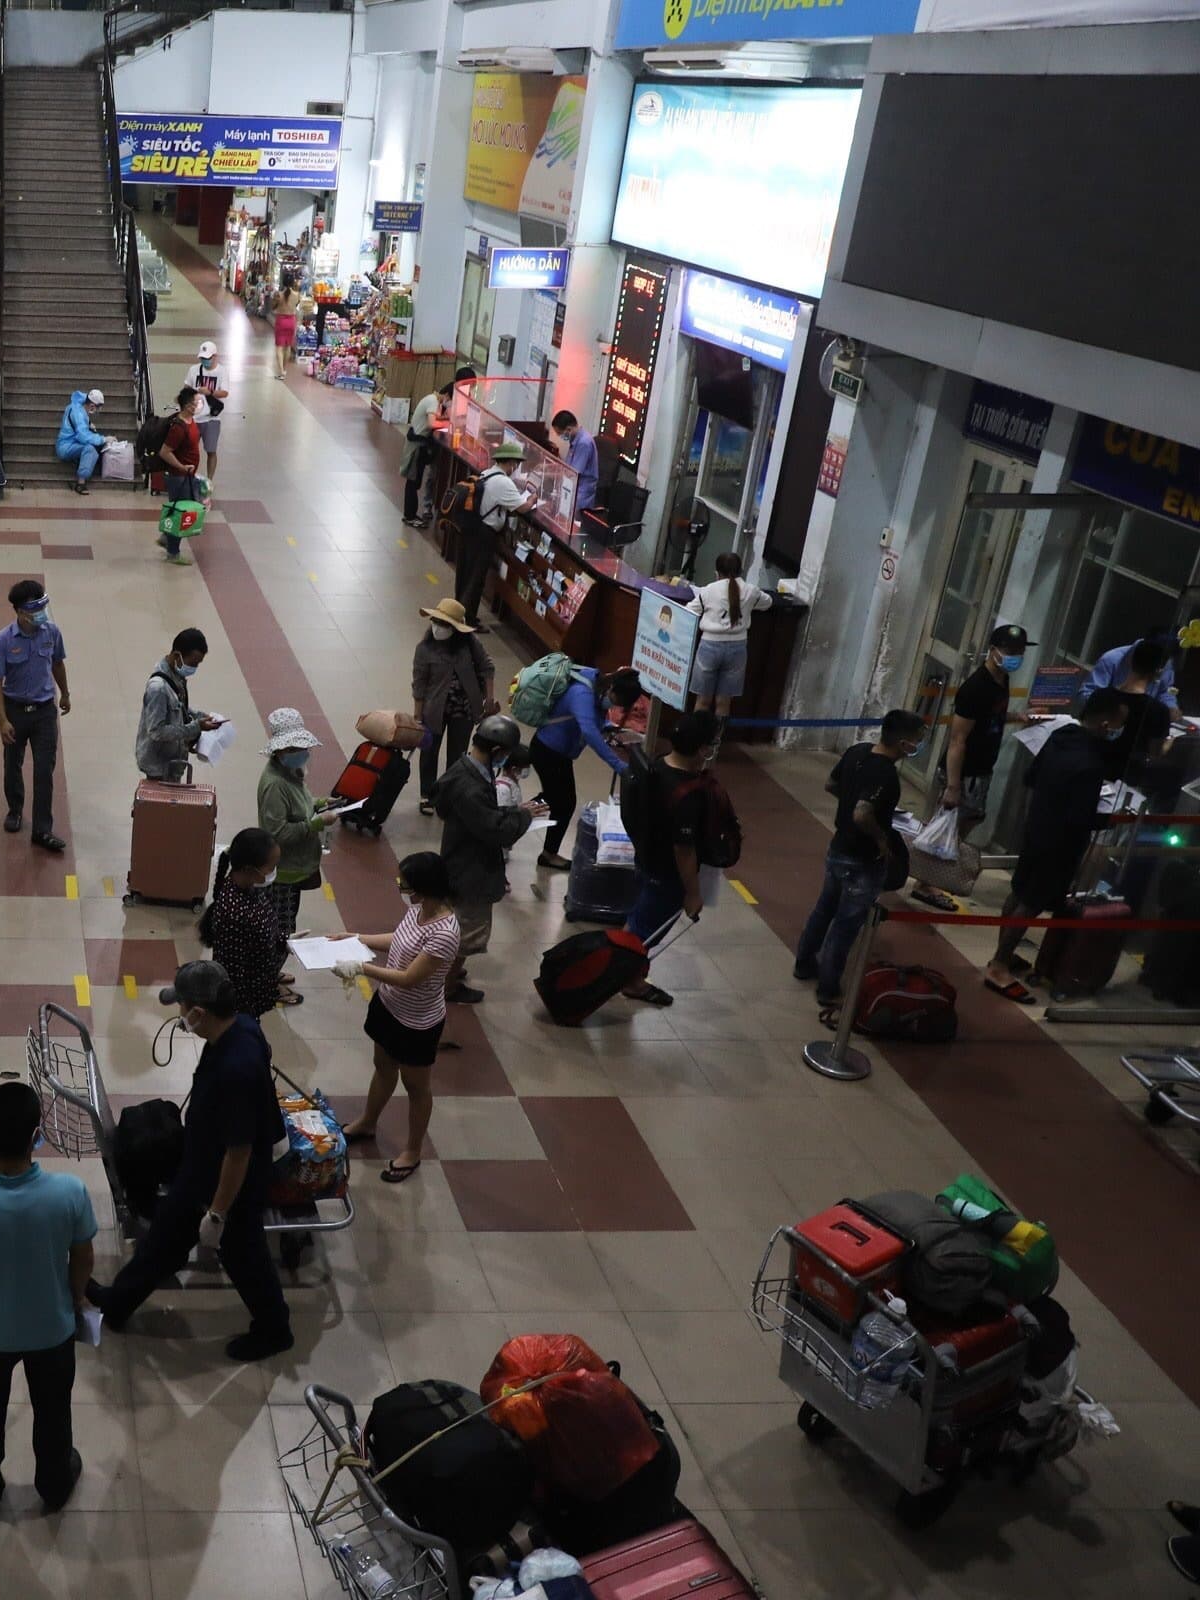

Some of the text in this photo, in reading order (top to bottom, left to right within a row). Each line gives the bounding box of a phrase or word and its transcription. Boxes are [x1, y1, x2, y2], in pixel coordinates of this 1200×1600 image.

[119, 120, 203, 133] Điện máy XANH
[141, 135, 202, 152] SIÊU TỐC
[224, 129, 325, 143] Máy lạnh TOSHIBA
[130, 149, 211, 177] SIÊU RẺ
[499, 252, 560, 271] HƯỚNG DẪN
